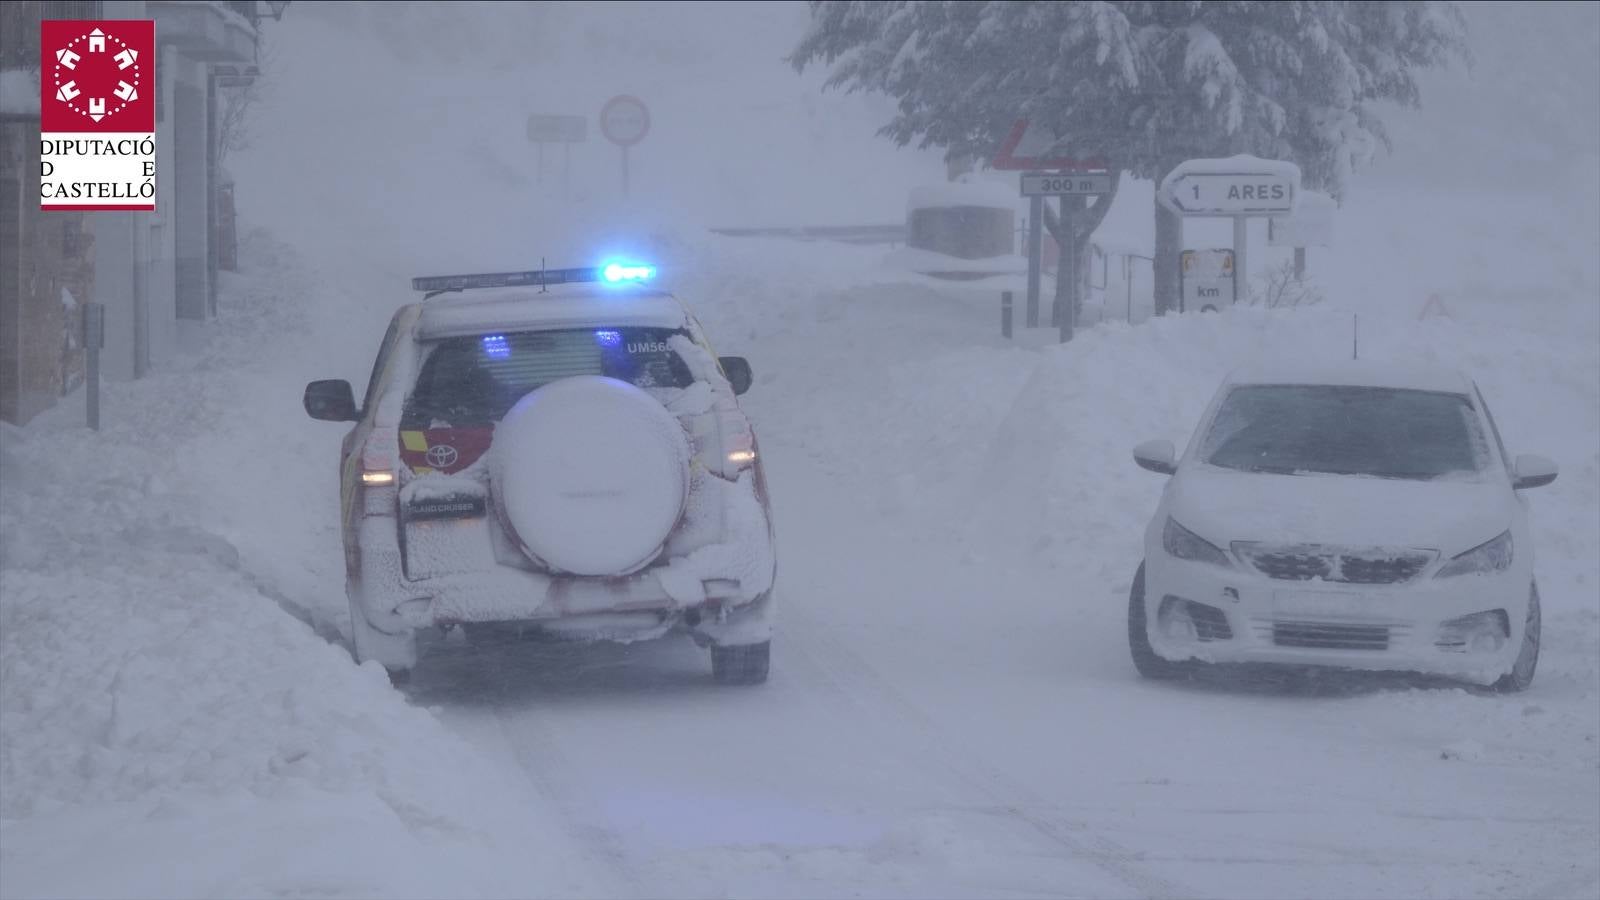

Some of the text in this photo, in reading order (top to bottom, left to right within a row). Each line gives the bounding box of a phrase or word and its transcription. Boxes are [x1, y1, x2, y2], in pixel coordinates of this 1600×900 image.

[1040, 178, 1093, 192] 300 m
[1191, 184, 1285, 201] 1 ARES
[1197, 285, 1220, 297] km
[437, 502, 474, 513] CRUISER
